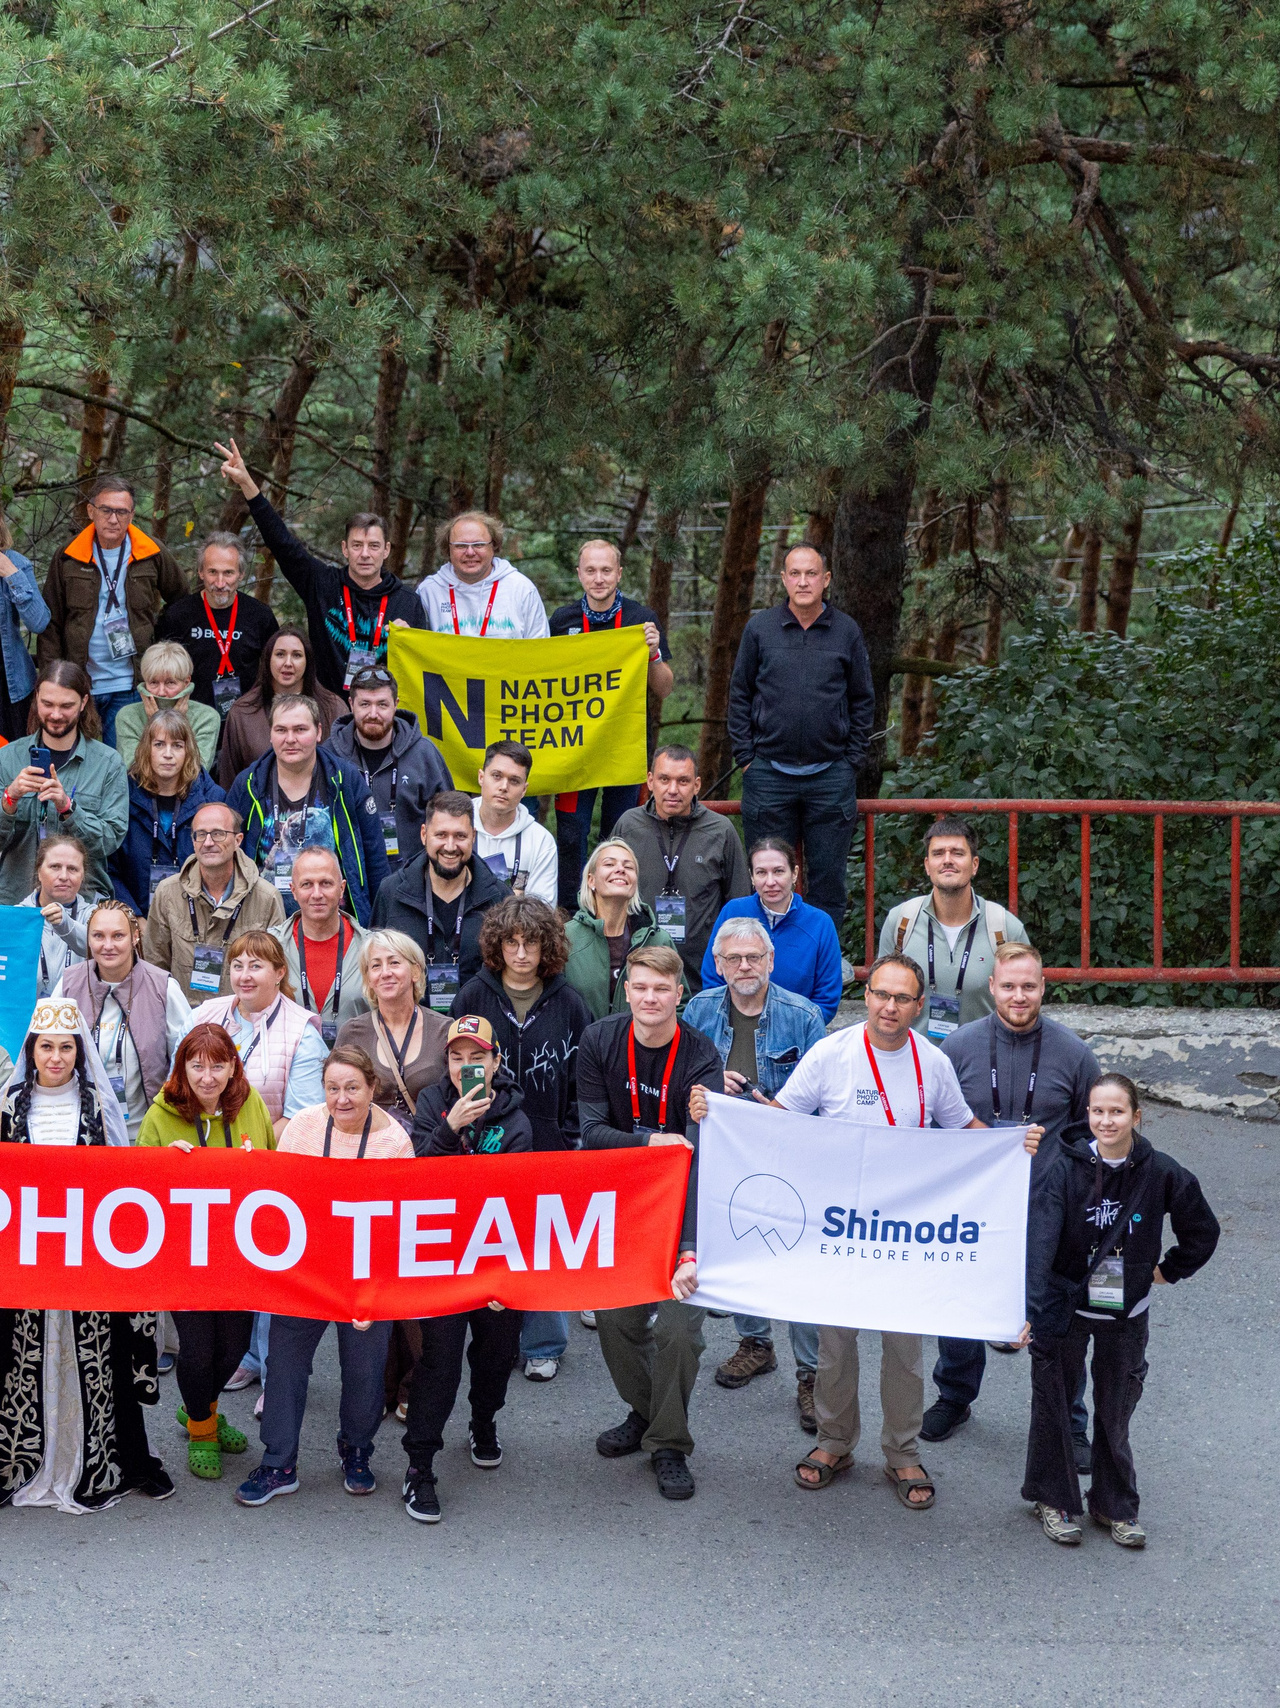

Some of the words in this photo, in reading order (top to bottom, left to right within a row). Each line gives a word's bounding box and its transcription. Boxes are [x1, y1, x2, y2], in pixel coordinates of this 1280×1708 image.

[500, 668, 622, 700] NATURE
[422, 671, 486, 750] N
[500, 697, 605, 724] PHOTO
[500, 725, 584, 750] TEAM
[640, 1083, 660, 1097] TEAM
[880, 1091, 889, 1111] Canon
[331, 1191, 617, 1280] TEAM
[821, 1205, 980, 1245] Shimoda
[820, 1243, 909, 1261] EXPLORE
[923, 1251, 977, 1262] MORE
